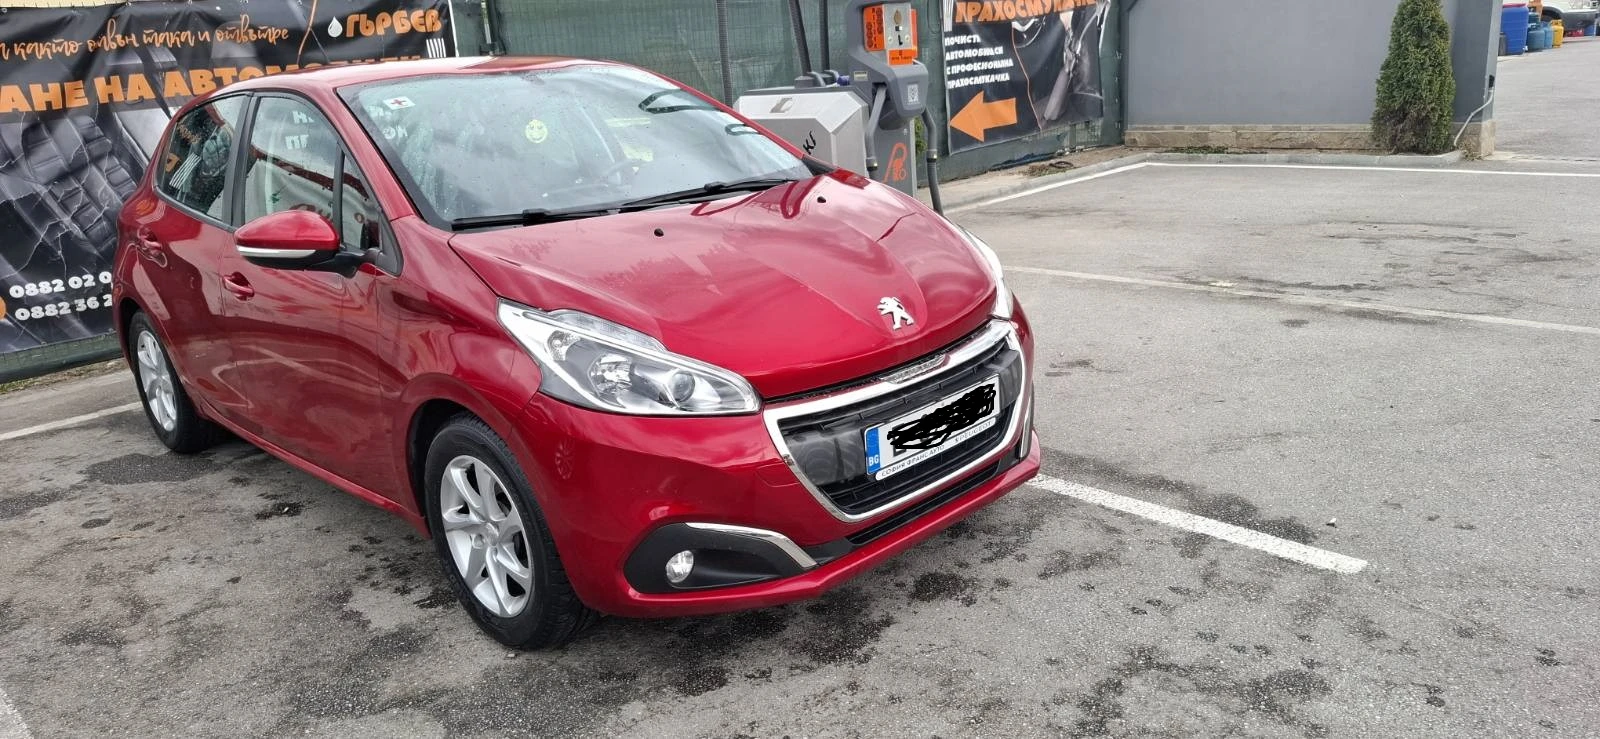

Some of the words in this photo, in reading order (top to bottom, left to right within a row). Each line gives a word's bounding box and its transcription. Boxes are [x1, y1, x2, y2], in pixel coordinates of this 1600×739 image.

[94, 73, 156, 104] НА
[9, 279, 66, 299] 0882
[68, 274, 96, 290] 02
[15, 301, 72, 321] 0882
[74, 296, 100, 312] 36
[868, 454, 880, 467] BG
